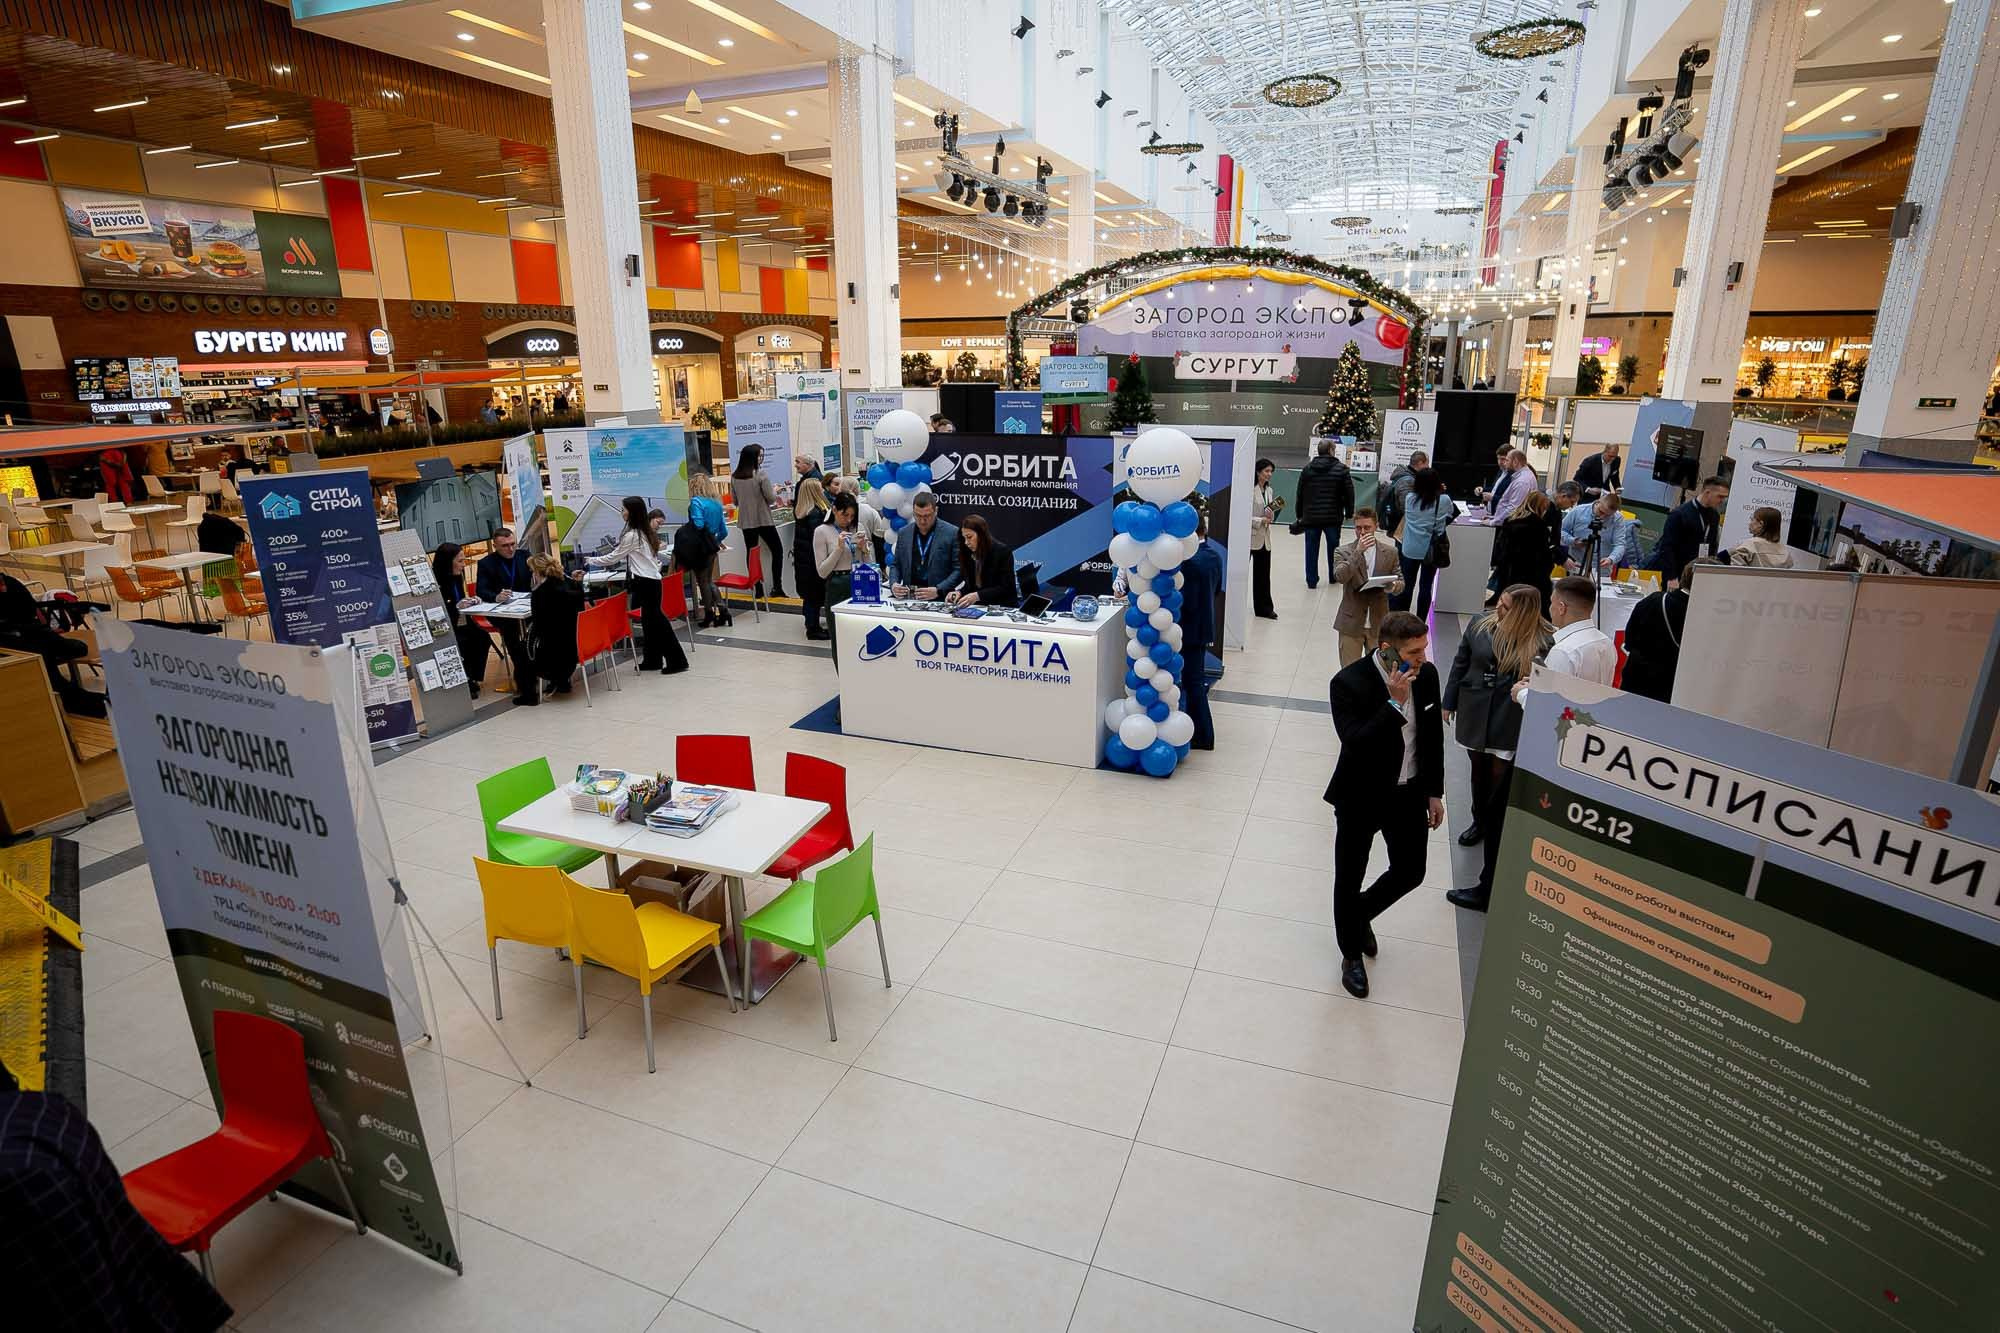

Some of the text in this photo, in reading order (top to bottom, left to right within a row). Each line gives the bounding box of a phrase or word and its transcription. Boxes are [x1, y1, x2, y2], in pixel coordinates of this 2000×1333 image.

[93, 216, 145, 228] ВКУСНО
[1134, 307, 1347, 325] ЗАГОРОД ЭКСПО
[195, 331, 347, 353] БУРГЕР КИНГ
[527, 338, 559, 352] ecco
[658, 337, 684, 350] ecco
[941, 338, 1005, 347] LOVE REPUBLIC
[1152, 329, 1326, 339] выставка загородной жизни
[1792, 341, 1825, 352] ГОШ
[1191, 358, 1279, 374] СУРГУТ
[962, 453, 1078, 479] ОРБИТА
[1135, 464, 1180, 476] ОРБИТА
[308, 487, 350, 501] СИТИ
[962, 478, 1078, 490] строительная компания
[311, 494, 363, 512] СТРОЙ
[998, 495, 1078, 510] СОЗИДАНИЯ
[268, 534, 299, 546] 2009
[320, 528, 349, 539] 400+
[273, 562, 287, 572] 10
[325, 553, 351, 565] 1500
[279, 586, 297, 598] 3%
[330, 579, 347, 590] 110
[284, 610, 309, 622] 35%
[335, 601, 374, 614] 10000+
[913, 629, 1070, 672] ОРБИТА
[131, 649, 287, 696] ЗАГОРОД ЭКСПО
[915, 659, 1072, 685] ТВОЯ ТРАЕКТОРИЯ ДВИЖЕНИЯ
[367, 719, 388, 730] 2.рф
[156, 713, 295, 779] ЗАГОРОДНАЯ
[156, 759, 329, 838] НЕДВИЖИМОСТЬ
[1566, 802, 1635, 846] 02.12
[1581, 734, 2000, 906] РАСПИСАНИ
[206, 819, 298, 878] ТЮМЕНИ
[213, 895, 234, 912] ТРЦ
[1539, 845, 1737, 942] 10:00 Начало работы выставки
[259, 890, 296, 912] 10:00
[306, 903, 341, 926] 21:00
[1526, 911, 1556, 934] 12:30
[1532, 879, 1774, 1005] 11:00 Официальное открытие выставки
[1520, 950, 1548, 974] 13:00
[1515, 977, 1542, 1001] 13:30
[1561, 941, 1724, 1030] Презентация квартала «Орбита»
[1510, 1005, 1538, 1029] 14:00
[1563, 930, 1872, 1091] Архитектура современного загородного строительства.
[349, 1031, 396, 1054] МОНОЛИТ
[1503, 1038, 1530, 1062] 14:30
[1496, 1072, 1523, 1097] 15:00
[1598, 991, 1654, 1027] Таунхаусы:
[1662, 1026, 1715, 1060] гармонии
[1725, 1059, 1788, 1098] природой,
[1799, 1098, 1861, 1137] любовью
[1872, 1137, 1948, 1183] комфорту
[1490, 1107, 1515, 1131] 15:30
[1545, 1024, 1611, 1069] Преимущества
[1703, 1117, 1776, 1165] Силикатный
[1777, 1160, 1824, 1193] кирпич
[1646, 1051, 1710, 1092] коттеджный
[1711, 1088, 1760, 1120] посёлок
[1761, 1115, 1783, 1133] без
[1784, 1128, 1883, 1188] компромиссов
[373, 1117, 420, 1146] ОРБИТА
[1484, 1139, 1509, 1163] 16:00
[1538, 1060, 1830, 1245] Инновационные отделочные материалы 2023-2024 года.
[1478, 1162, 1503, 1187] 16:30
[1472, 1194, 1496, 1219] 17:00
[1463, 1241, 1493, 1271] 18:30
[1458, 1265, 1488, 1297] 19:00
[1638, 1251, 1697, 1297] СТАБИЛИС
[1451, 1290, 1482, 1321] 21:00
